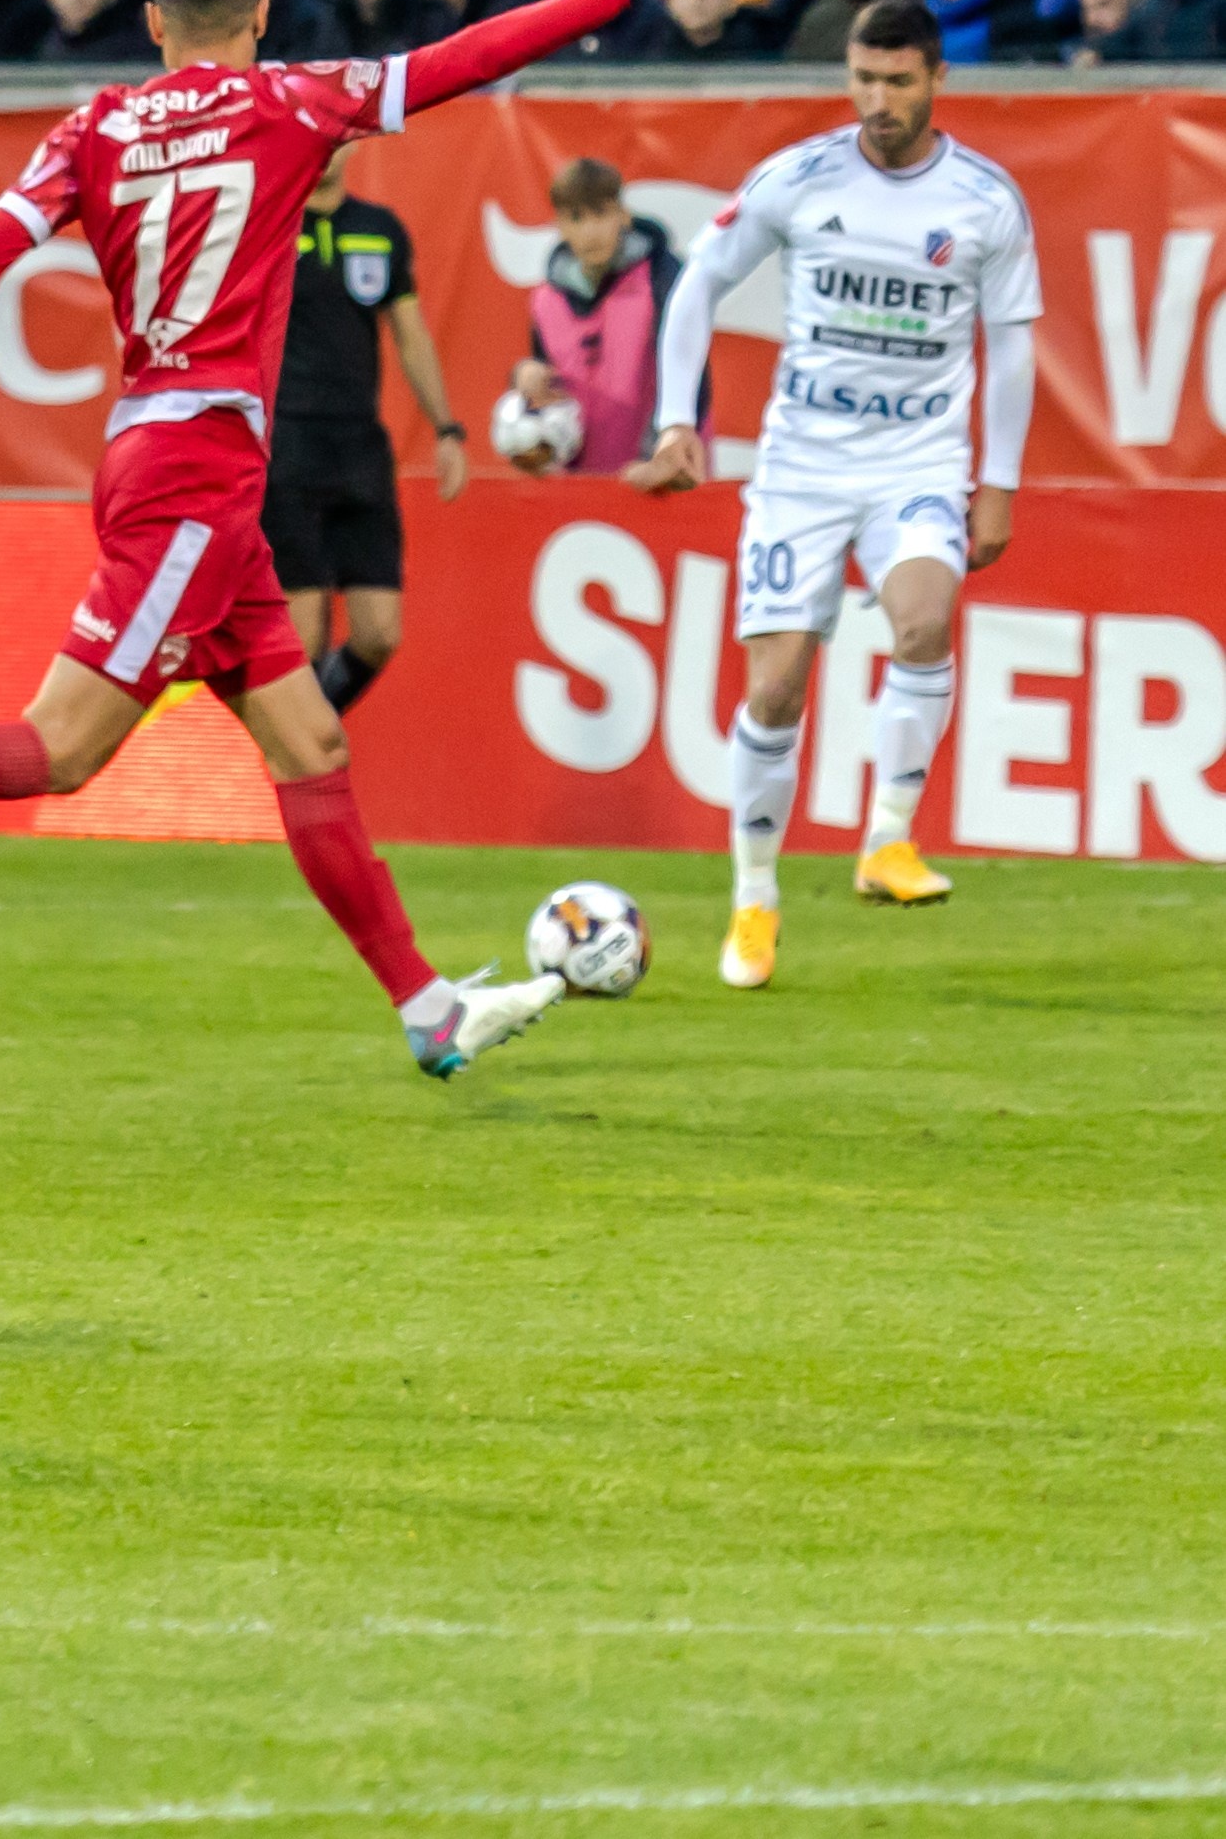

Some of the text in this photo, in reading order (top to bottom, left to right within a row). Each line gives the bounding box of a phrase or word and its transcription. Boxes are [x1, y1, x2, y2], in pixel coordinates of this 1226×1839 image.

[110, 159, 255, 337] 77
[812, 267, 958, 317] UNIBET
[786, 368, 952, 422] ELSACO
[747, 541, 796, 595] 30
